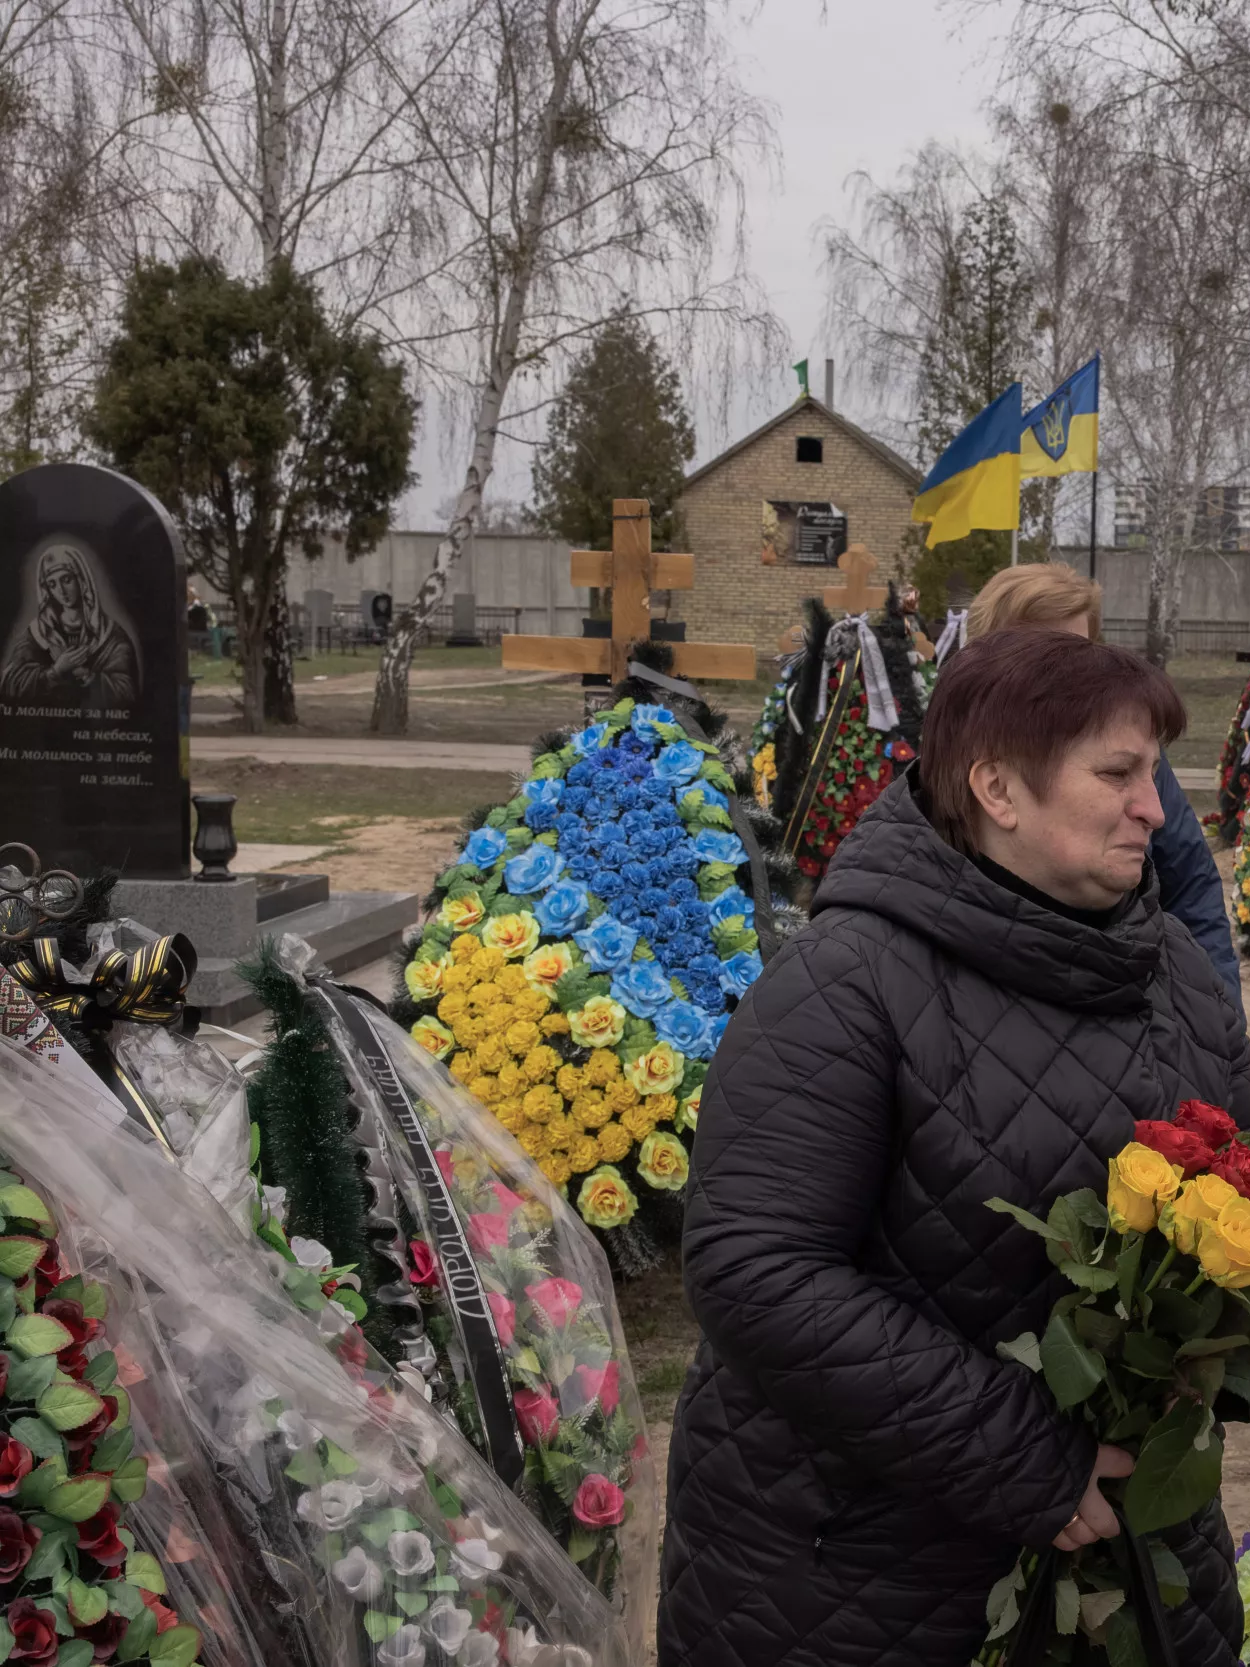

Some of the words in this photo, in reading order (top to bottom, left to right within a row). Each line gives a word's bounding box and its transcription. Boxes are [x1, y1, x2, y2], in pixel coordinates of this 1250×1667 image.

[16, 706, 81, 718] молишся
[85, 708, 101, 718] за
[105, 709, 130, 719] нас
[73, 730, 90, 740] на
[94, 728, 153, 743] небесах,
[21, 750, 93, 762] молимось
[97, 752, 112, 762] за
[116, 750, 153, 763] тебе
[80, 774, 97, 784] на
